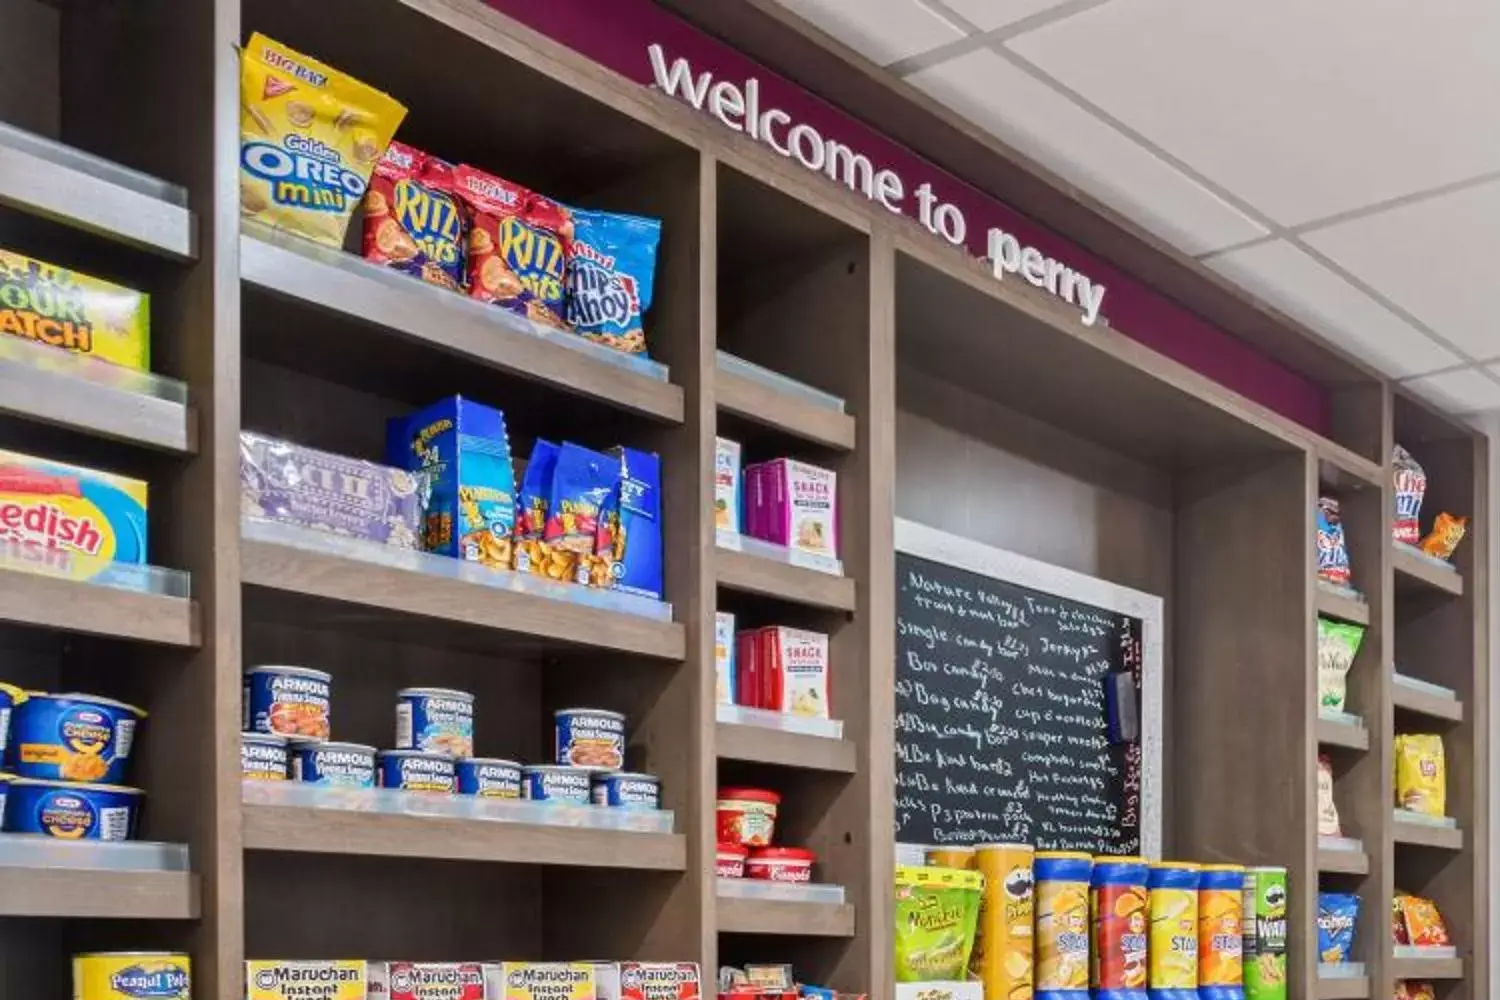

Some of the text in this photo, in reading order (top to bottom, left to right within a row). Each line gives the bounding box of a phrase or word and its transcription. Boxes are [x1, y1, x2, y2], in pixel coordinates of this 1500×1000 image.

[243, 143, 368, 197] OREO
[647, 44, 1106, 326] welcome to perry
[277, 180, 346, 213] mini
[110, 973, 160, 989] Peanut
[274, 967, 359, 982] Maruchan
[408, 968, 479, 984] Maruchan
[524, 969, 589, 982] Maruchan
[635, 970, 697, 982] Maruchan
[281, 984, 338, 996] Instant
[415, 986, 462, 997] Instant
[528, 983, 573, 993] Instant
